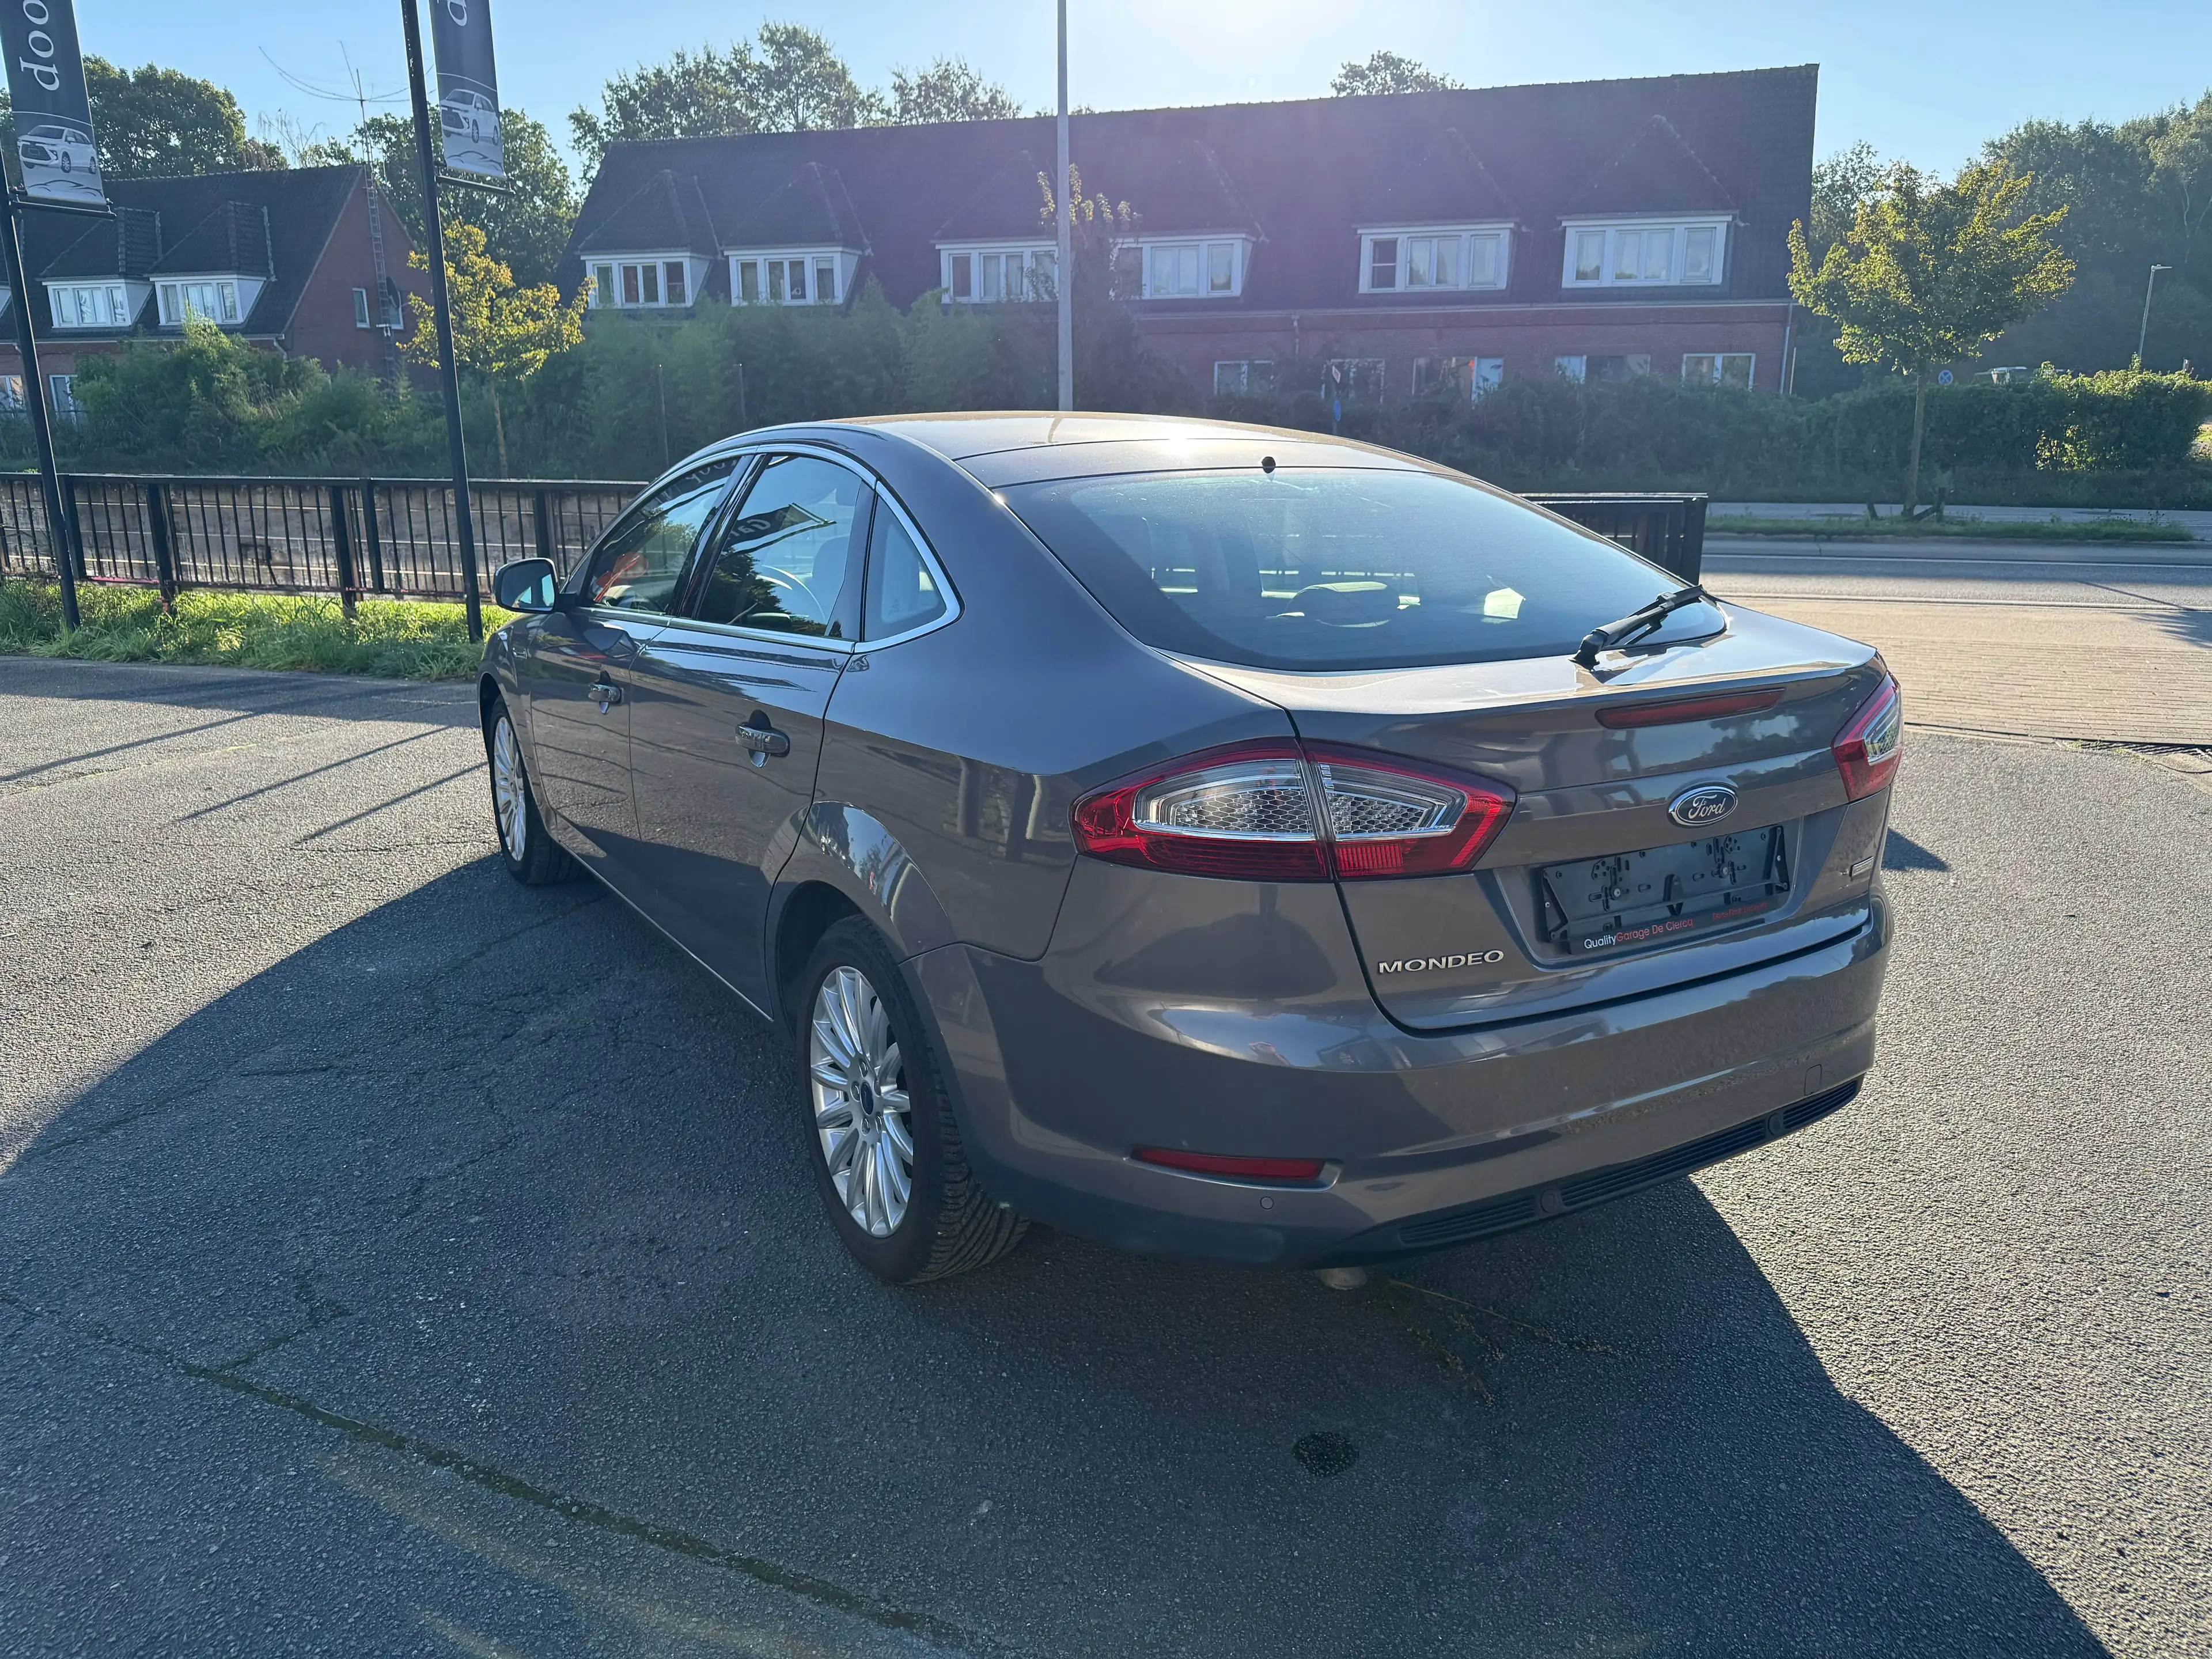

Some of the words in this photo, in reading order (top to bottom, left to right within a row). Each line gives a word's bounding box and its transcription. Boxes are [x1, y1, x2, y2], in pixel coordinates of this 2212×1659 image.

[1688, 794, 1726, 819] Ford
[1584, 930, 1650, 949] QualityGarage
[1652, 925, 1664, 934] De
[1379, 949, 1504, 974] MONDEO
